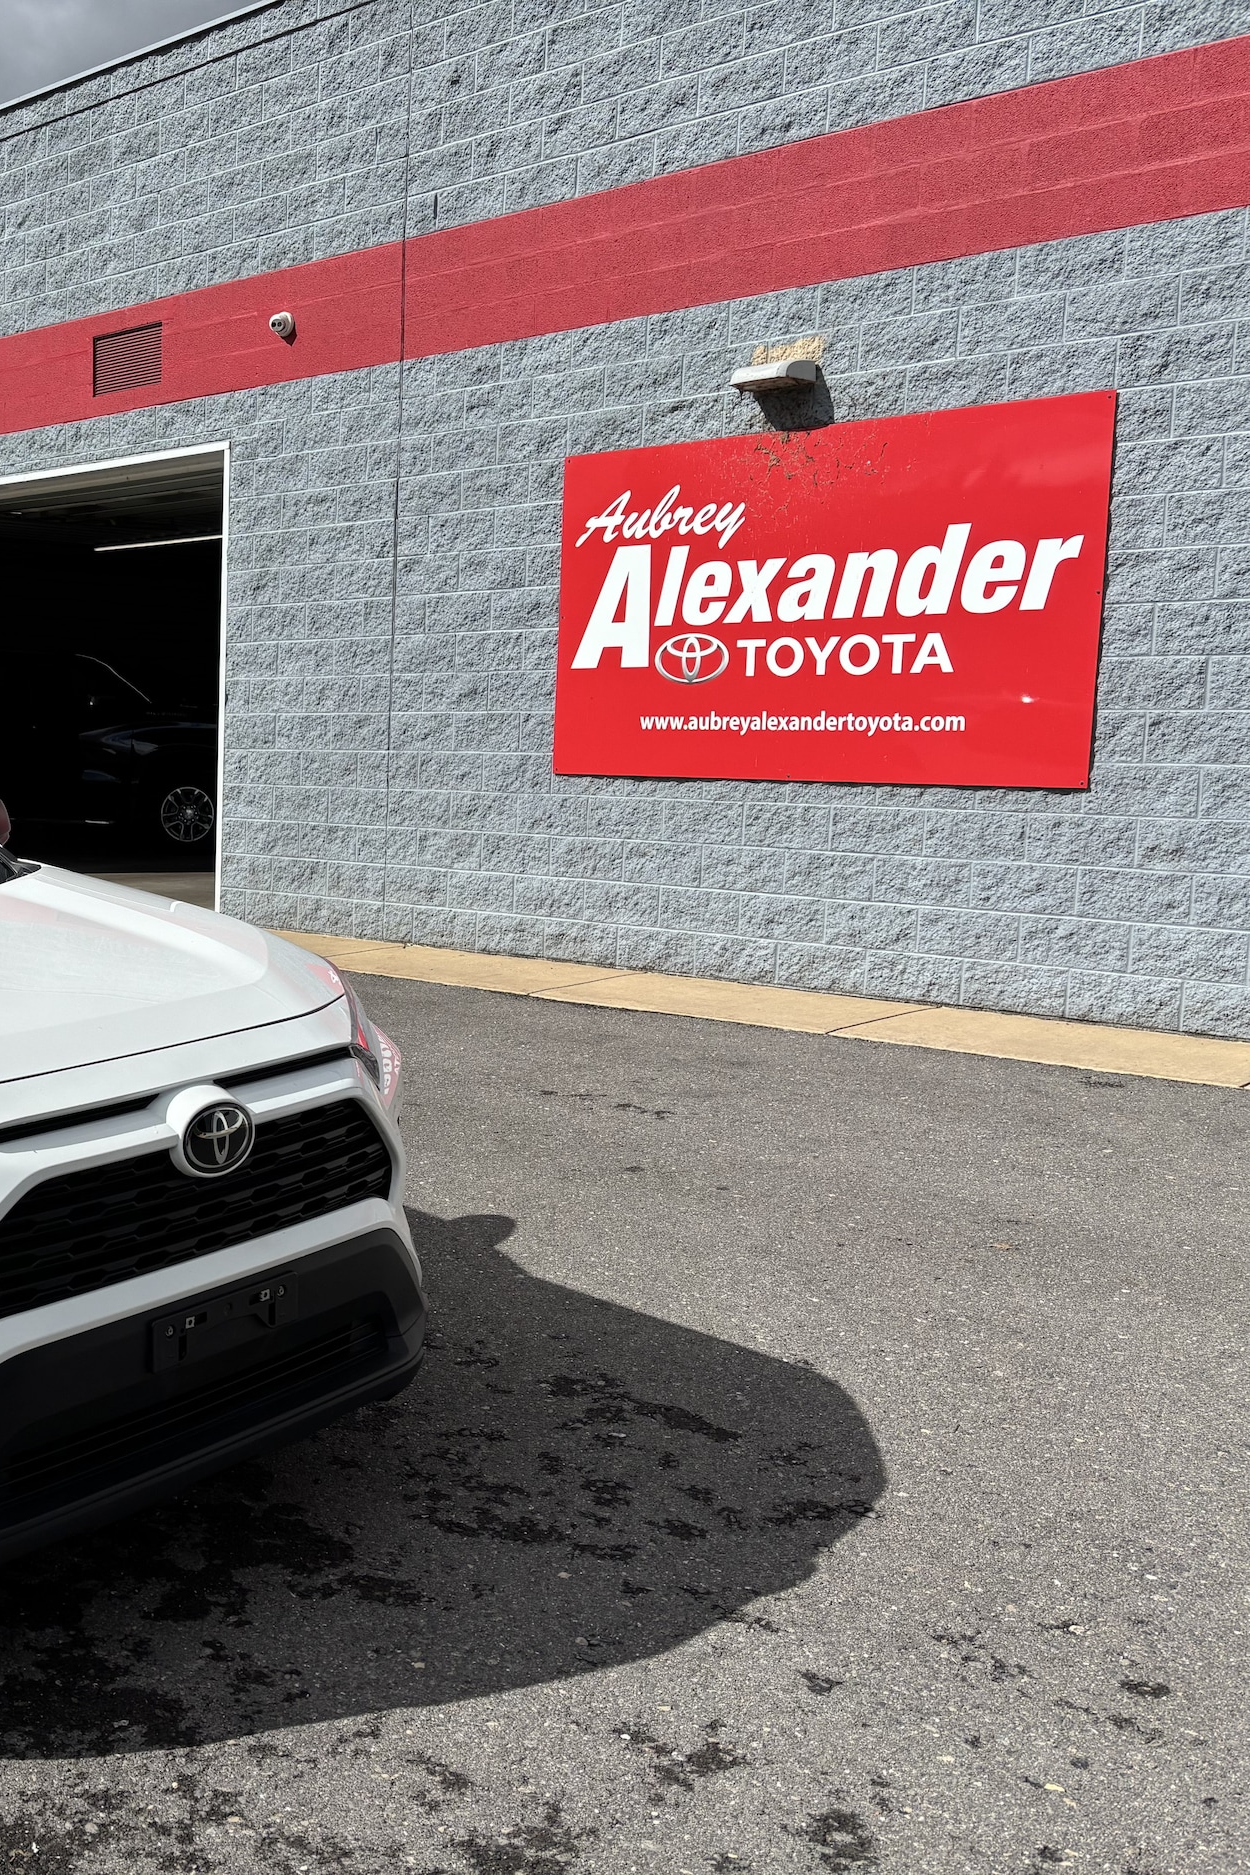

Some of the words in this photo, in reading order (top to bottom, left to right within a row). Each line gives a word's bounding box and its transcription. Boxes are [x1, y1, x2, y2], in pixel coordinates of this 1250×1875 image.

[575, 484, 746, 550] Aubrey
[570, 522, 1085, 670] Alexander
[736, 632, 954, 677] TOYOTA
[639, 710, 966, 737] www.aubreyalexandertoyota.com
